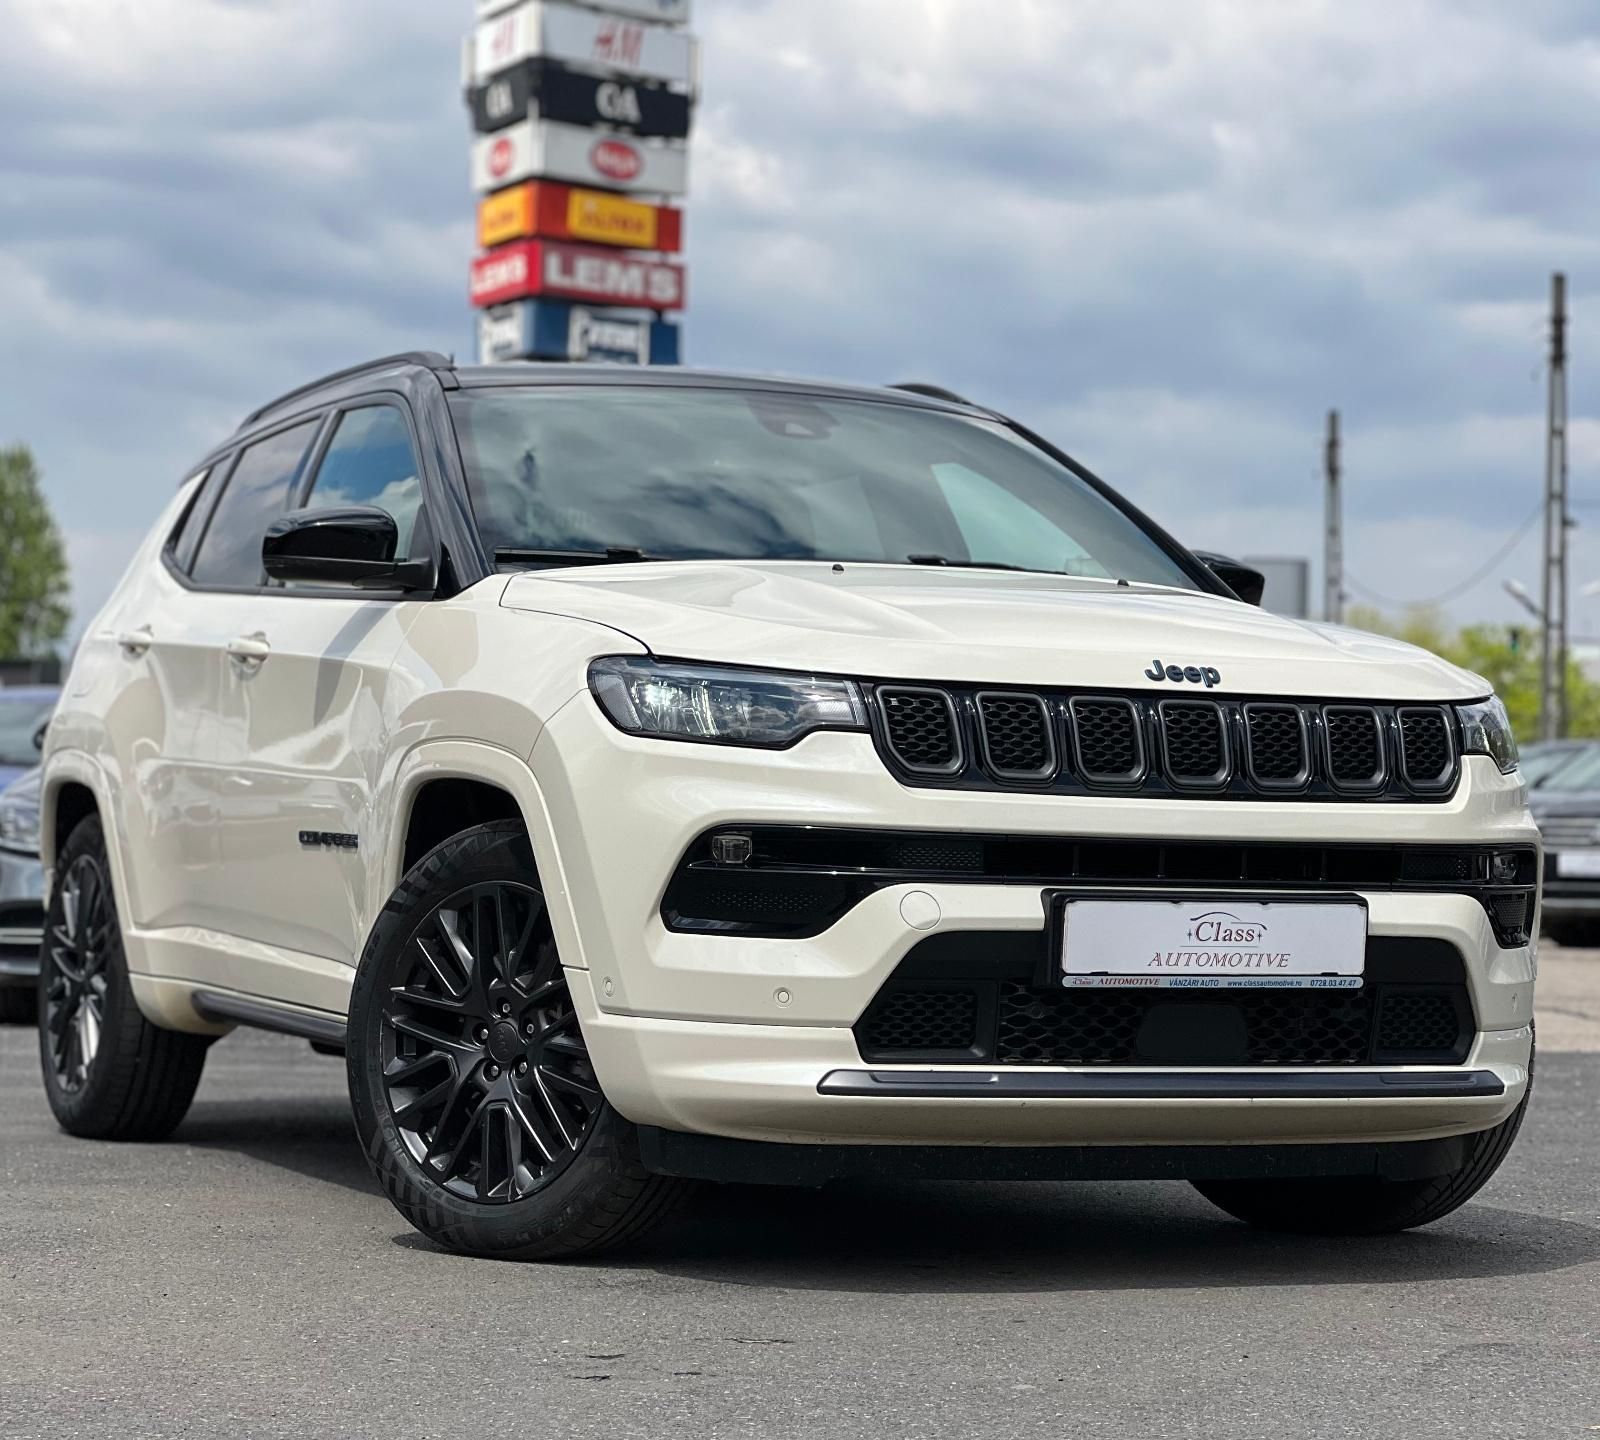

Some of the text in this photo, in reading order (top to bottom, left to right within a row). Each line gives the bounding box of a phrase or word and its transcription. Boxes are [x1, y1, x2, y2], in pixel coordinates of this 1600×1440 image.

[1144, 659, 1221, 688] Jeep
[1195, 921, 1255, 942] Class
[1147, 952, 1291, 968] AUTOMOTIVE
[1098, 978, 1160, 986] AUTOMOTIVE
[1200, 979, 1219, 987] AUTO
